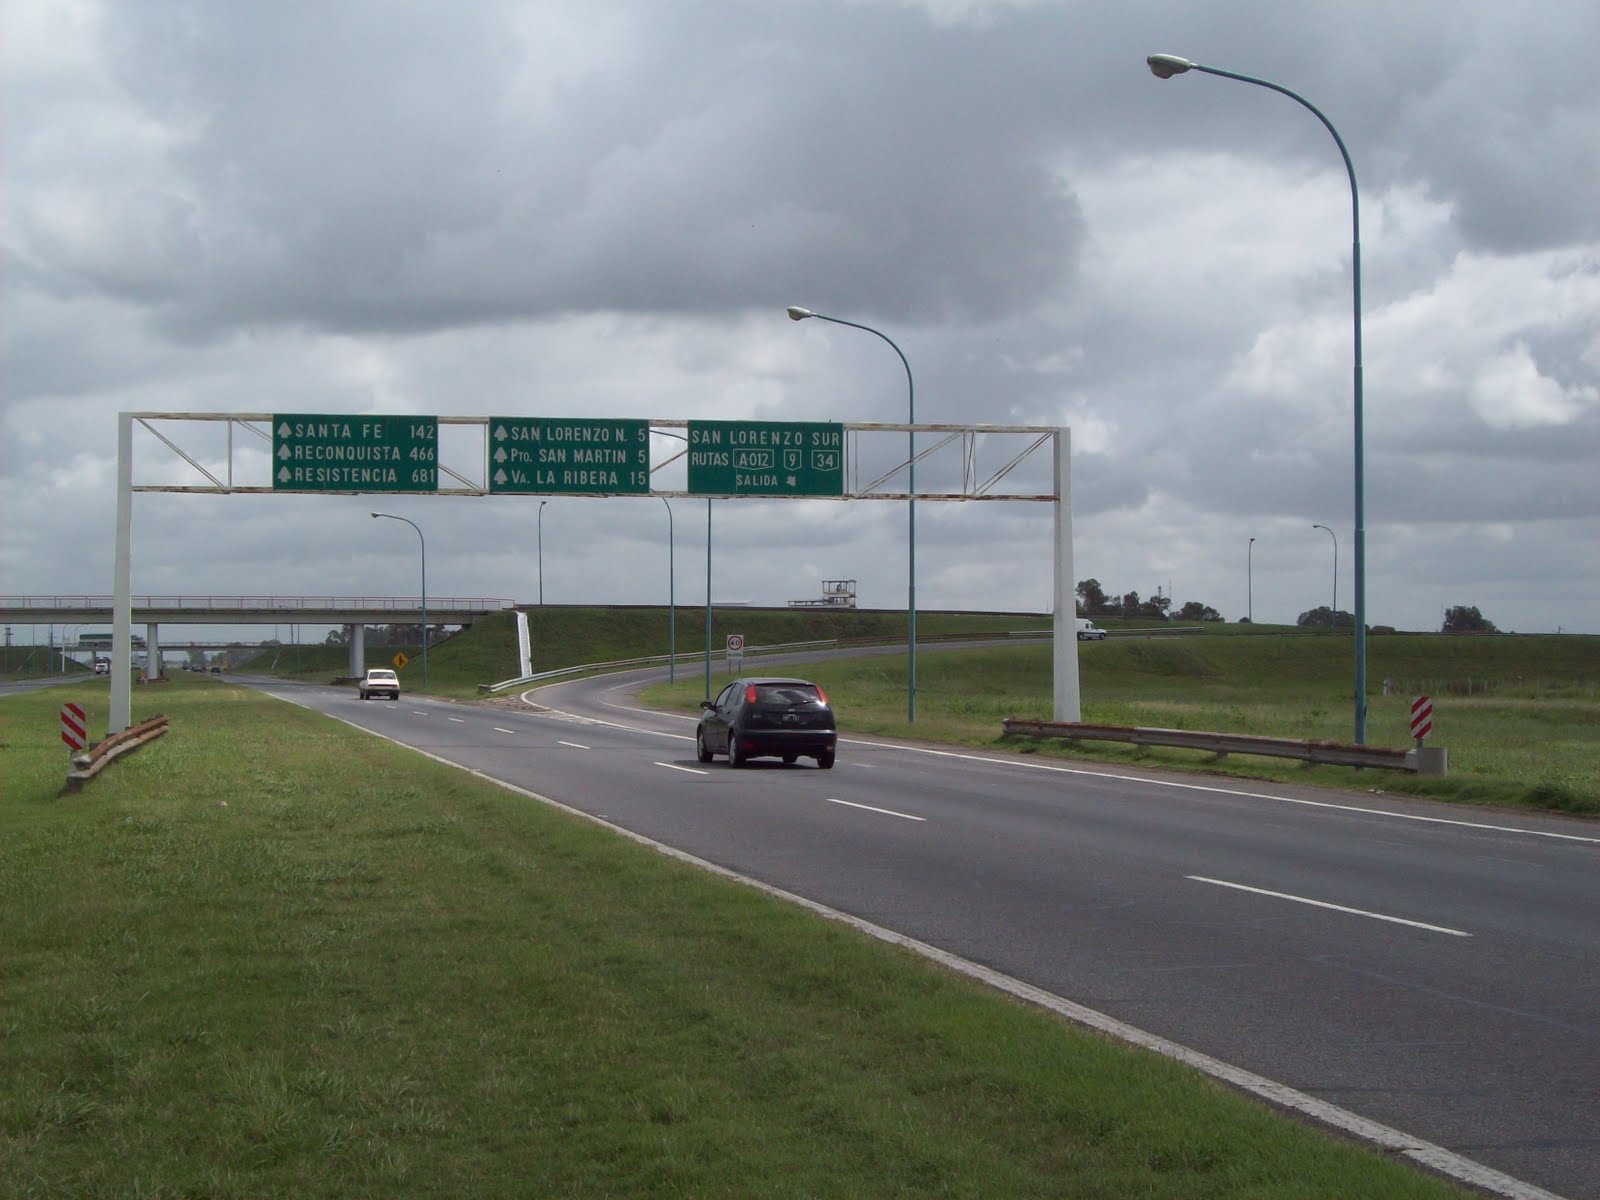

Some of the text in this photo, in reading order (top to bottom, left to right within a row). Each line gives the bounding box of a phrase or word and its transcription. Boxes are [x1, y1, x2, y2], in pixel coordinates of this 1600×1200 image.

[296, 424, 433, 438] SANTA FE 142
[511, 427, 645, 442] SAN LORENZO N. 5
[692, 430, 839, 445] SAN LORENZO SUR
[295, 446, 433, 461] RECONQUISTA 466
[540, 449, 566, 462] SAN
[574, 449, 626, 463] MARTIN
[638, 451, 645, 463] 5
[692, 452, 728, 466] RUTAS
[789, 454, 796, 467] 9
[817, 454, 833, 467] 34
[296, 468, 433, 483] RESISTENCIA 681
[537, 470, 555, 484] LA
[564, 471, 617, 485] RIBERA
[630, 472, 645, 485] 15
[736, 475, 777, 486] SALIDA
